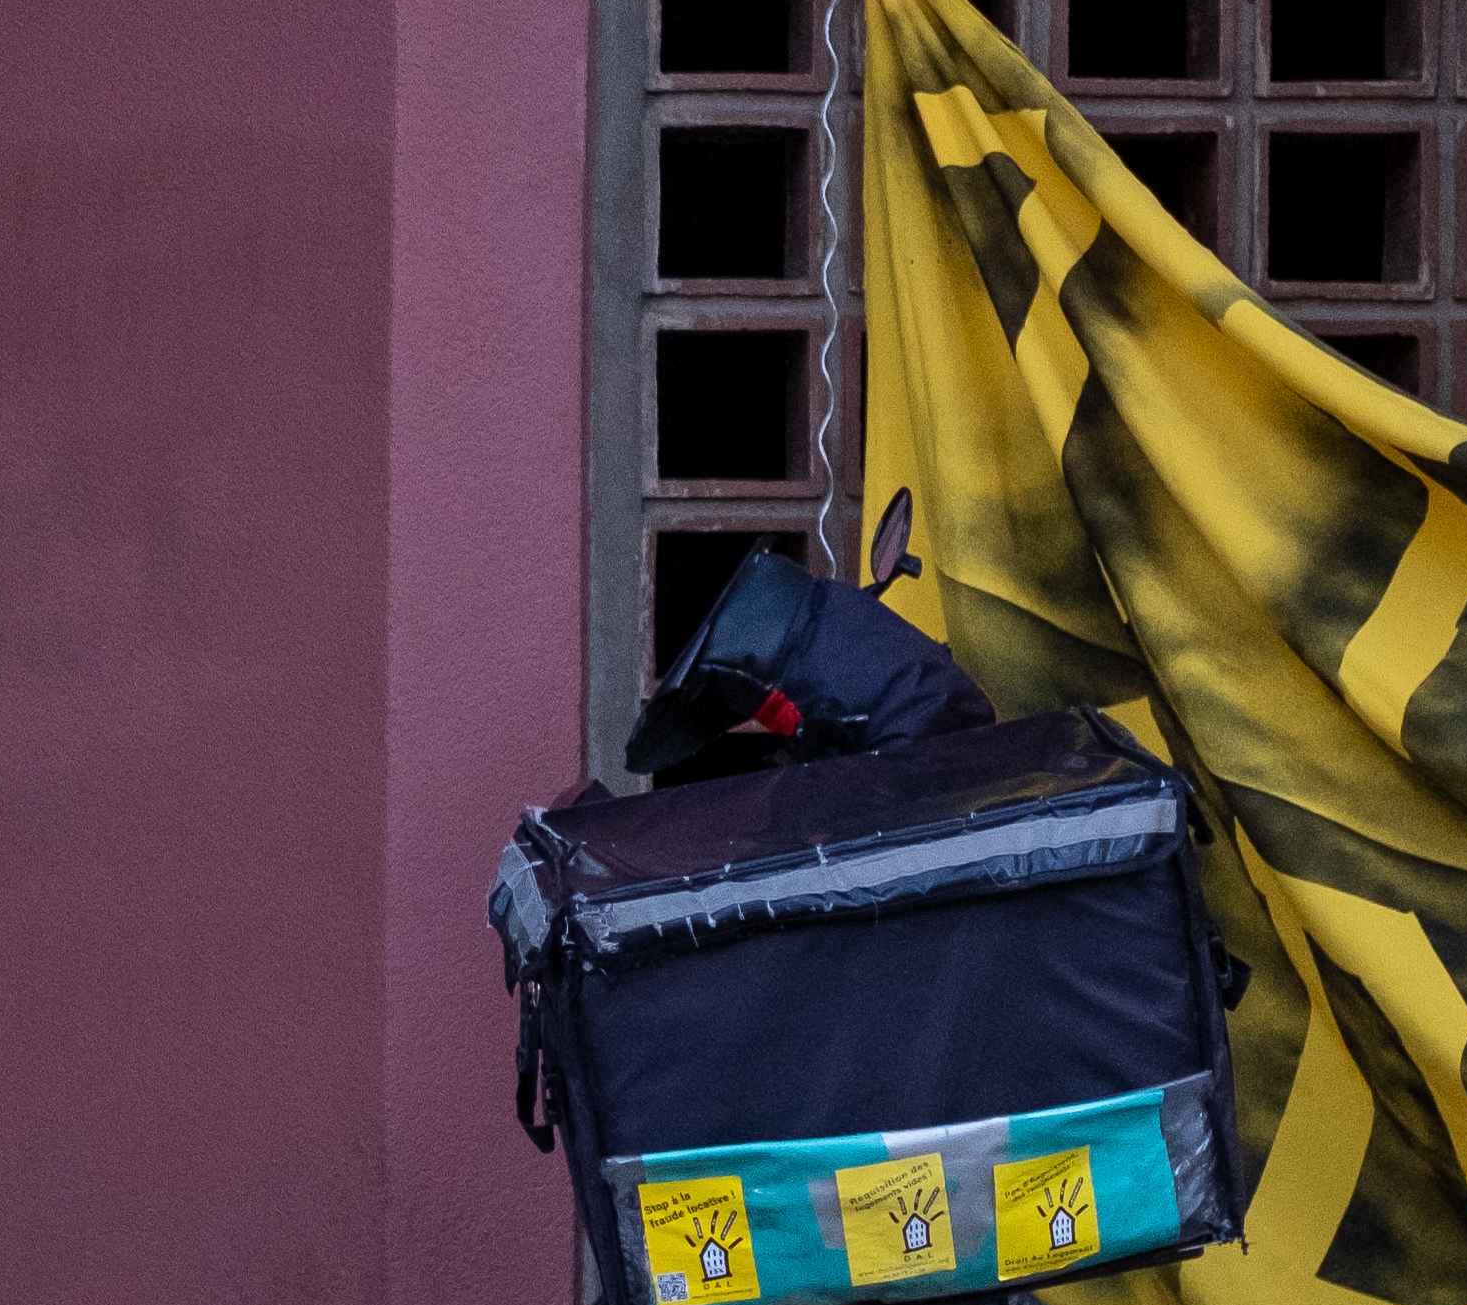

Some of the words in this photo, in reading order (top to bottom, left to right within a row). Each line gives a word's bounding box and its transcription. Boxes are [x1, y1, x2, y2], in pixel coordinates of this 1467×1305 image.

[644, 1200, 670, 1215] Stop
[681, 1192, 692, 1201] la
[649, 1210, 685, 1230] fraude
[687, 1195, 730, 1215] locative
